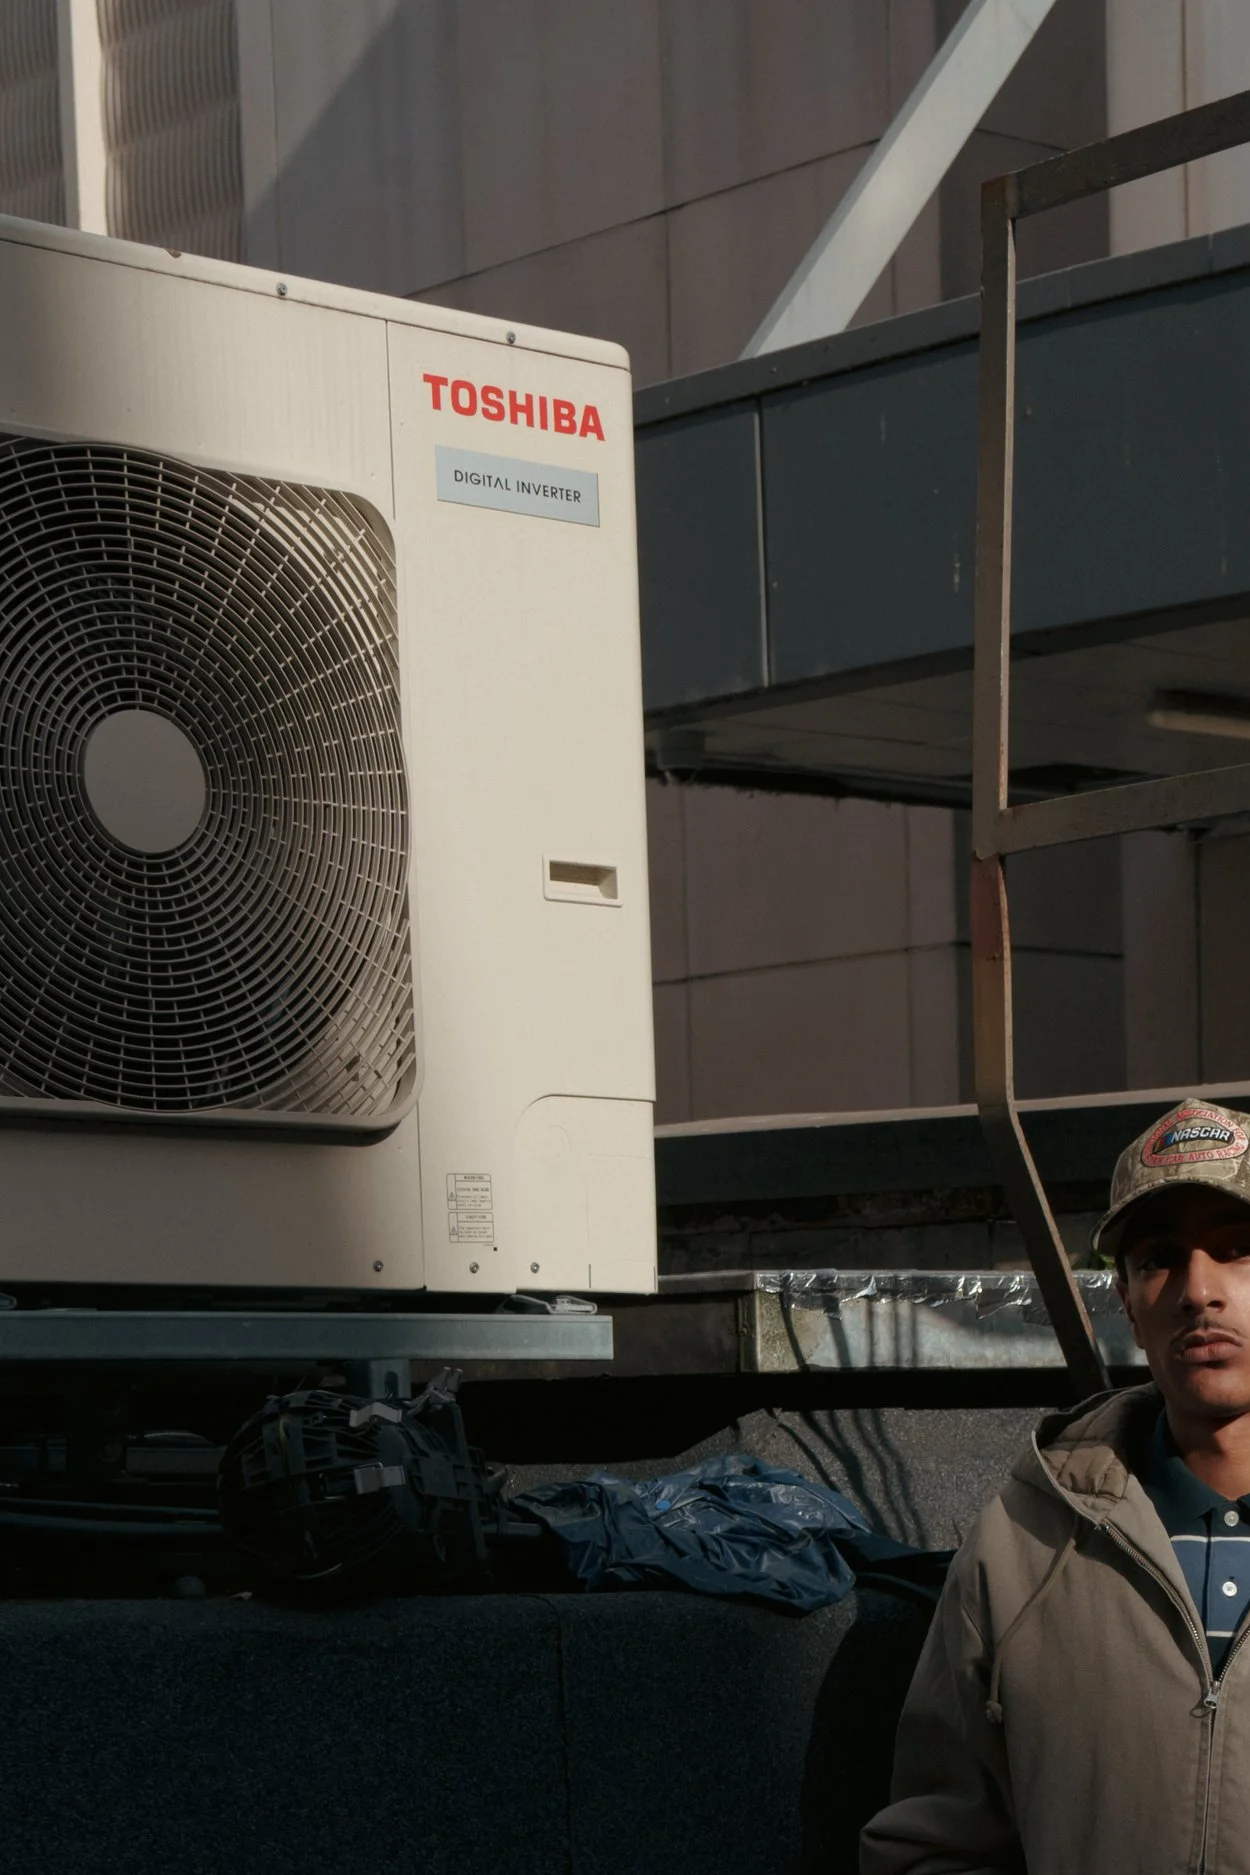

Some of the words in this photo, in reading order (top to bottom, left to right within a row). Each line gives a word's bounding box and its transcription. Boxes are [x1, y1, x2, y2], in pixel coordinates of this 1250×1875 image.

[423, 373, 605, 441] TOSHIBA
[454, 469, 511, 491] DIGITAL
[516, 480, 581, 503] INVERTER
[1171, 1126, 1230, 1143] NASCAR
[1189, 1151, 1214, 1161] AUTO
